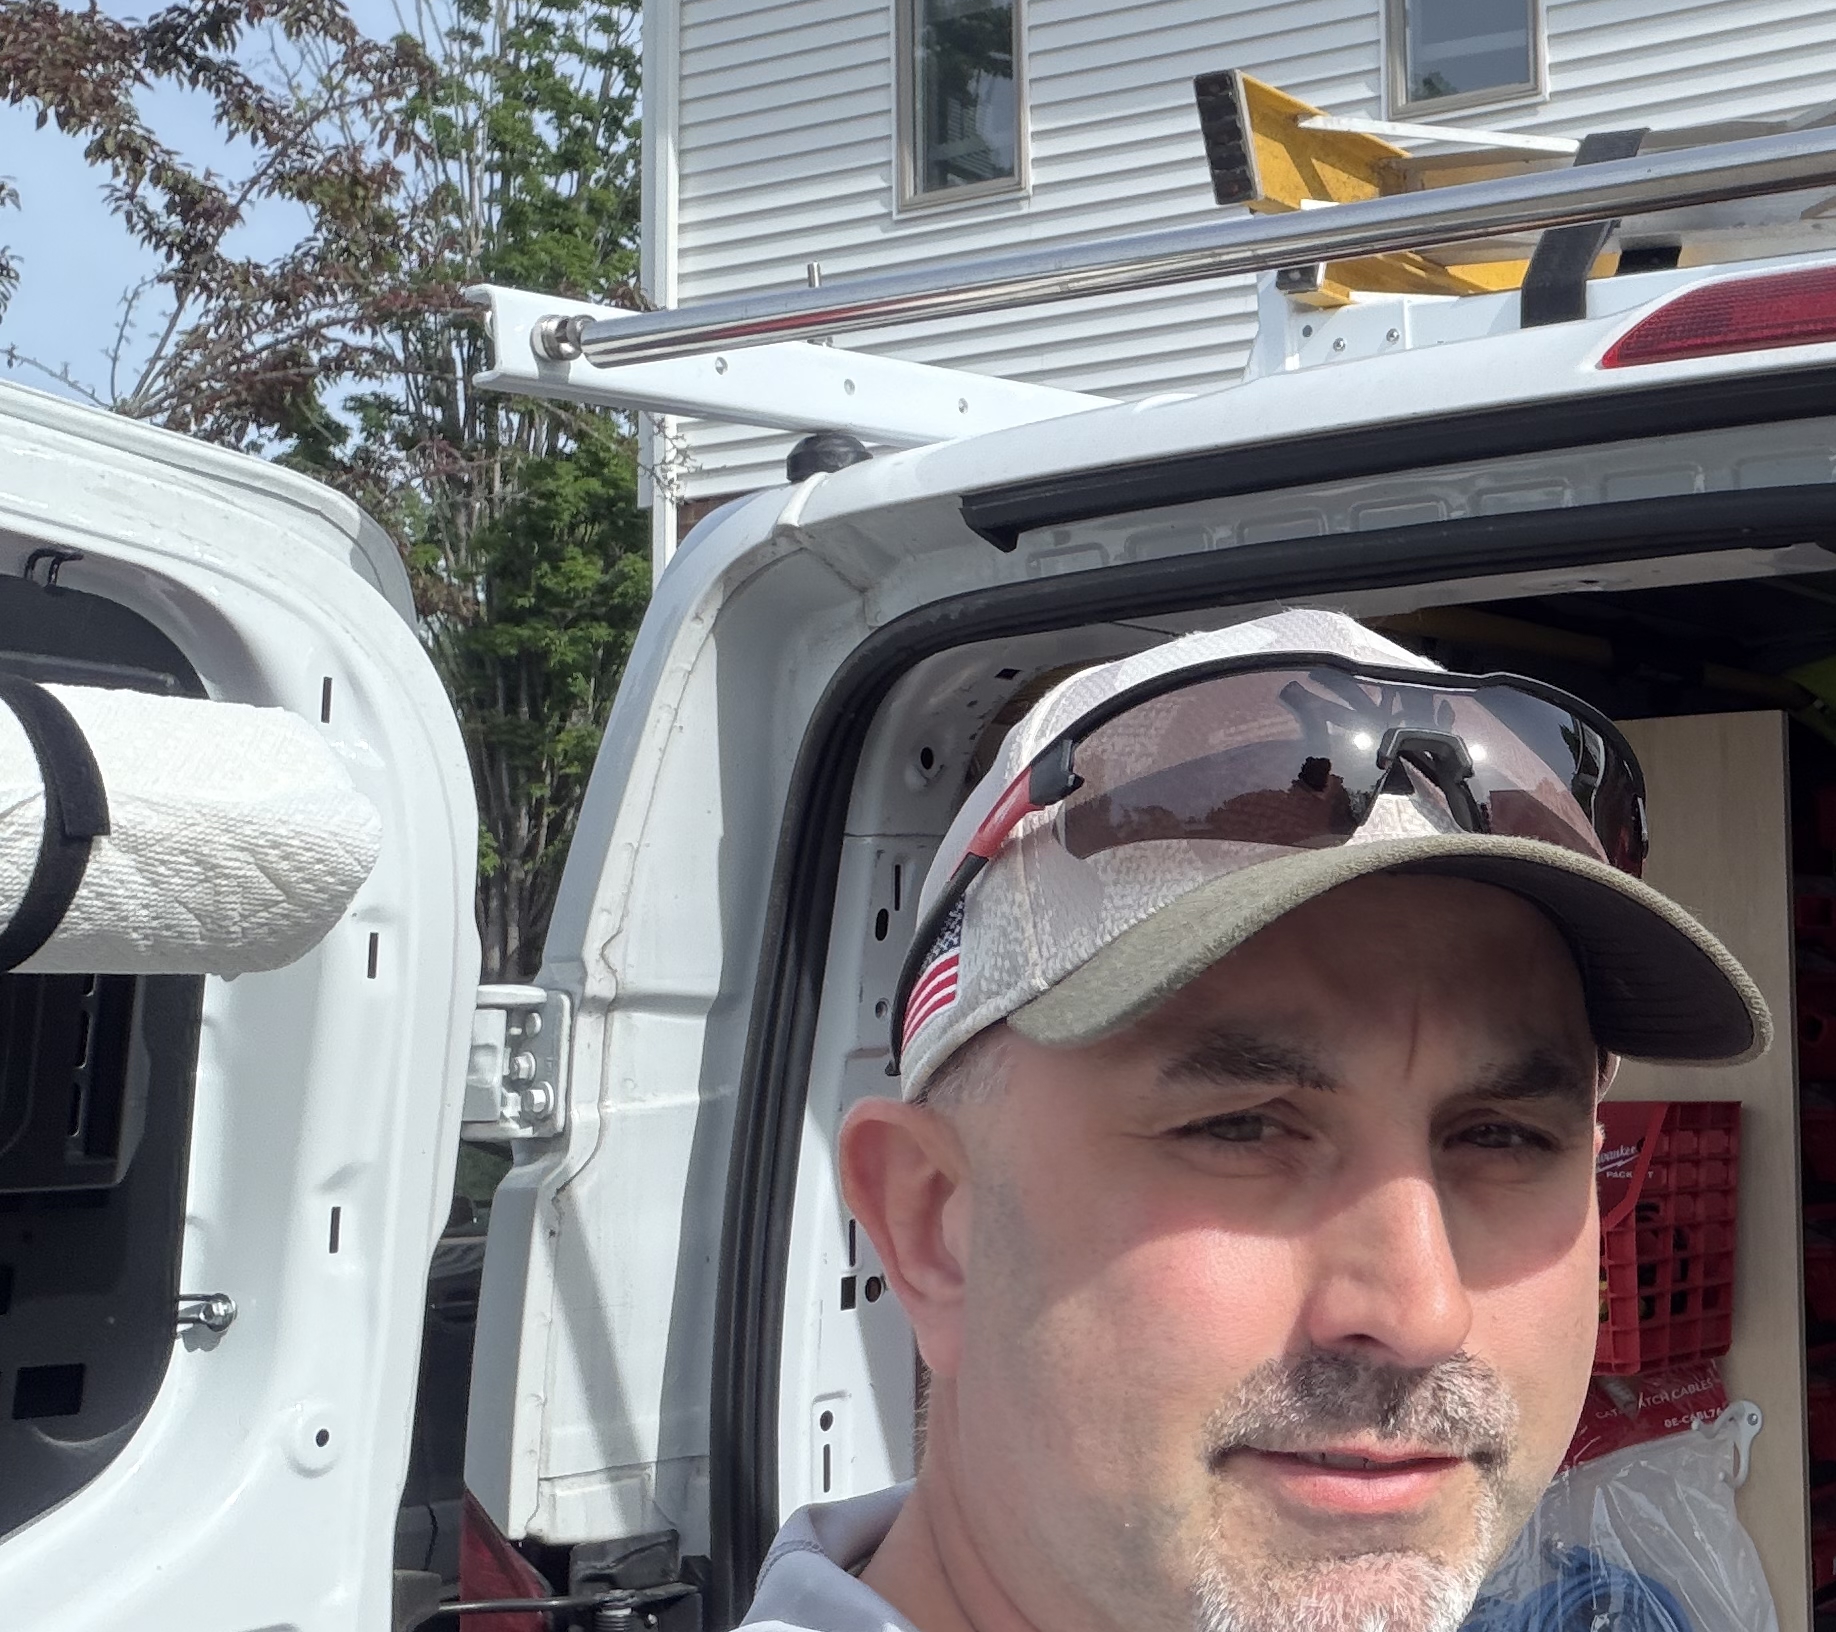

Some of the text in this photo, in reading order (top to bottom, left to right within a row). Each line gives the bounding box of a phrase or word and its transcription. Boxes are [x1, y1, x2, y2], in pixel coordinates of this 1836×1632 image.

[1599, 1144, 1637, 1163] waukee
[1606, 1170, 1654, 1179] PACKT
[1672, 1379, 1713, 1399] CABLES
